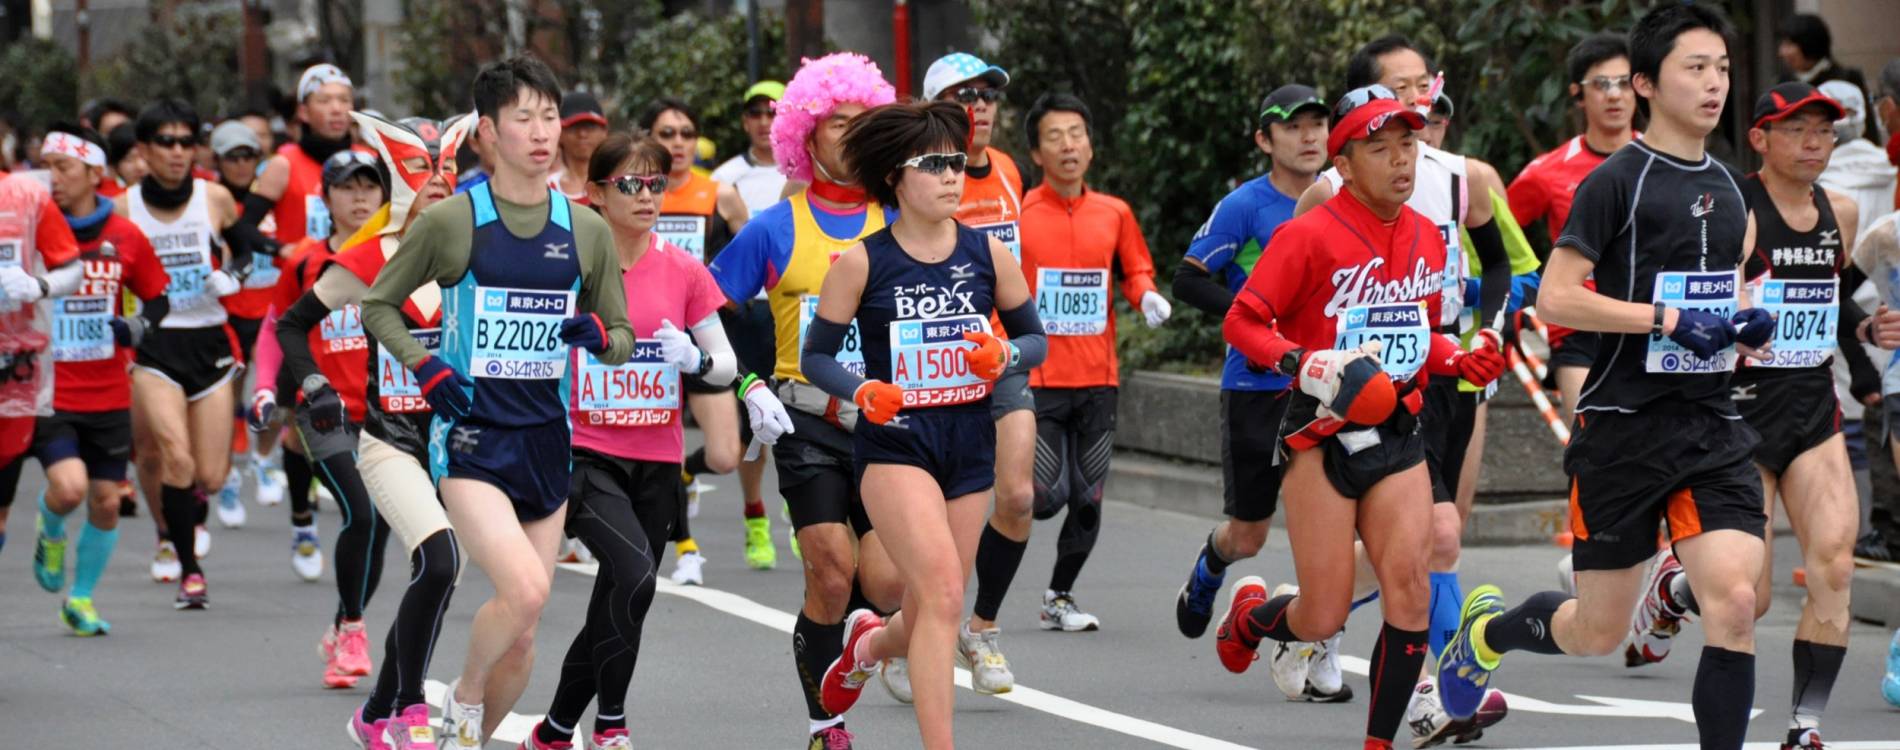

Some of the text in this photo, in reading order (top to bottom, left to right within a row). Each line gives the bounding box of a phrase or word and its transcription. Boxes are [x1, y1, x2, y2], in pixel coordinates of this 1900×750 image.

[894, 283, 936, 297] スーパー
[1689, 281, 1733, 294] 東京メトロ
[1786, 288, 1833, 300] 東京メトロ
[509, 296, 565, 310] 東京メトロ
[1038, 291, 1098, 315] A 10893
[1370, 311, 1419, 323] 東京メトロ
[477, 318, 559, 352] B 22026
[926, 322, 981, 339] 東京メトロ
[1359, 333, 1418, 366] 753
[895, 351, 909, 381] A
[917, 346, 983, 380] 1500
[383, 359, 395, 387] A
[582, 369, 665, 402] A 15066
[919, 384, 987, 404] ランチパック
[604, 410, 671, 425] ランチパック
